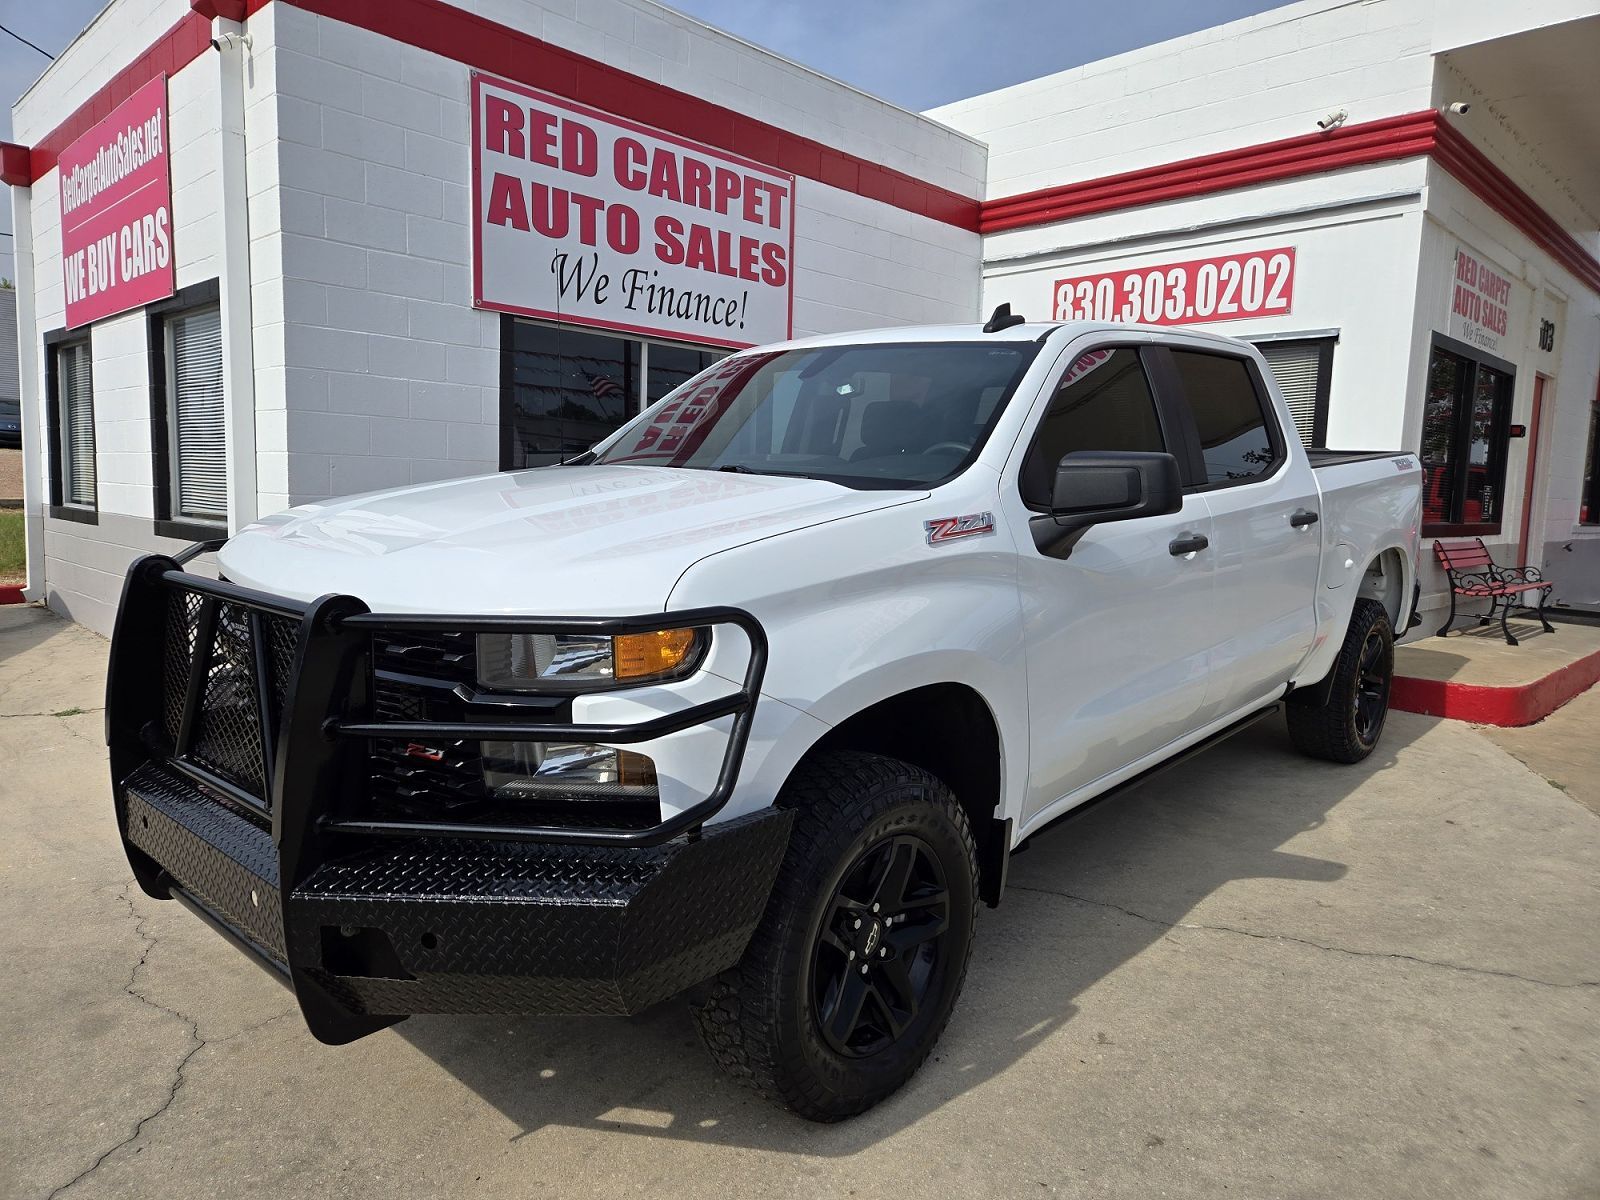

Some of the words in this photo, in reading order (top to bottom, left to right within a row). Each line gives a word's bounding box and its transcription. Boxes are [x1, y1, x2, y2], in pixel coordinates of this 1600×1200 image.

[63, 107, 163, 216] RedCarpetAutoSales.net
[485, 94, 598, 178] RED
[613, 137, 788, 230] CARPET
[64, 252, 87, 305] WE
[87, 232, 117, 296] BUY
[120, 206, 170, 282] CARS
[487, 172, 640, 255] AUTO
[654, 215, 787, 287] SALES
[550, 252, 610, 305] We
[622, 268, 748, 330] Finance!
[1055, 253, 1291, 324] 830.303.0202
[1453, 284, 1481, 323] AUTO
[1482, 300, 1508, 337] SALES
[1456, 251, 1478, 288] RED
[1478, 265, 1511, 307] CARPET
[1463, 321, 1474, 340] We
[923, 511, 996, 545] Z71
